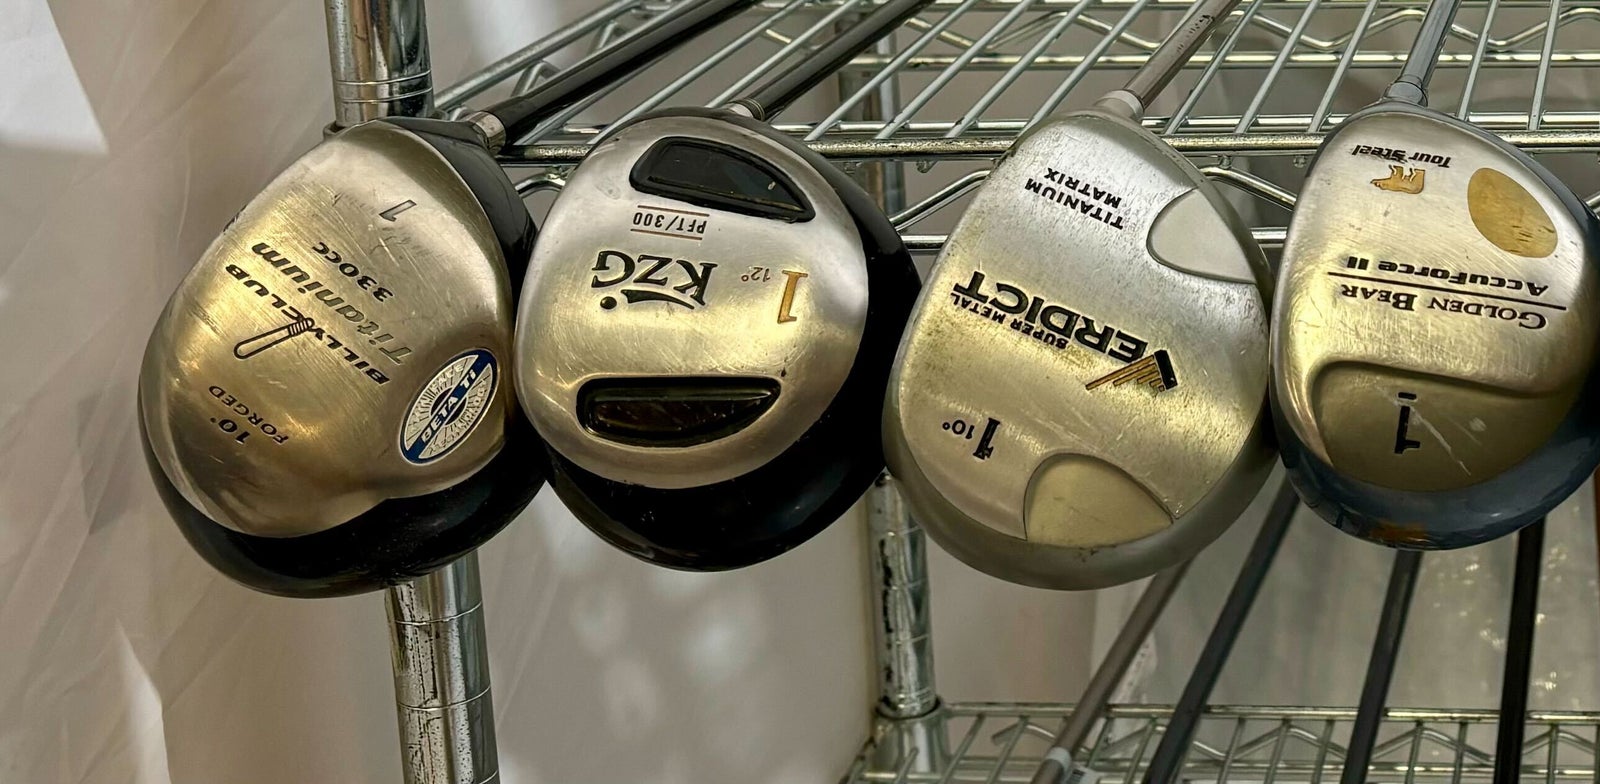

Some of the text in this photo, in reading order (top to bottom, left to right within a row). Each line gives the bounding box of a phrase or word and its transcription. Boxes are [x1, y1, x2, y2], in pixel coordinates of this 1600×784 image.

[1351, 144, 1452, 168] Tour Steel
[379, 199, 418, 225] 1
[1024, 178, 1125, 230] TITANIUM
[1044, 167, 1122, 209] MATRIX
[633, 211, 706, 234] PFT/300
[311, 241, 394, 303] 330cc
[591, 250, 718, 307] KZG
[777, 269, 809, 324] 1
[251, 242, 413, 366] Titanium
[950, 292, 1070, 350] SUPER METAL
[953, 271, 1178, 391] VERDICT
[1341, 283, 1547, 330] GOLDEN BEAR
[208, 385, 289, 445] FORGED
[421, 369, 477, 443] BETA Ti
[973, 417, 1001, 460] 1
